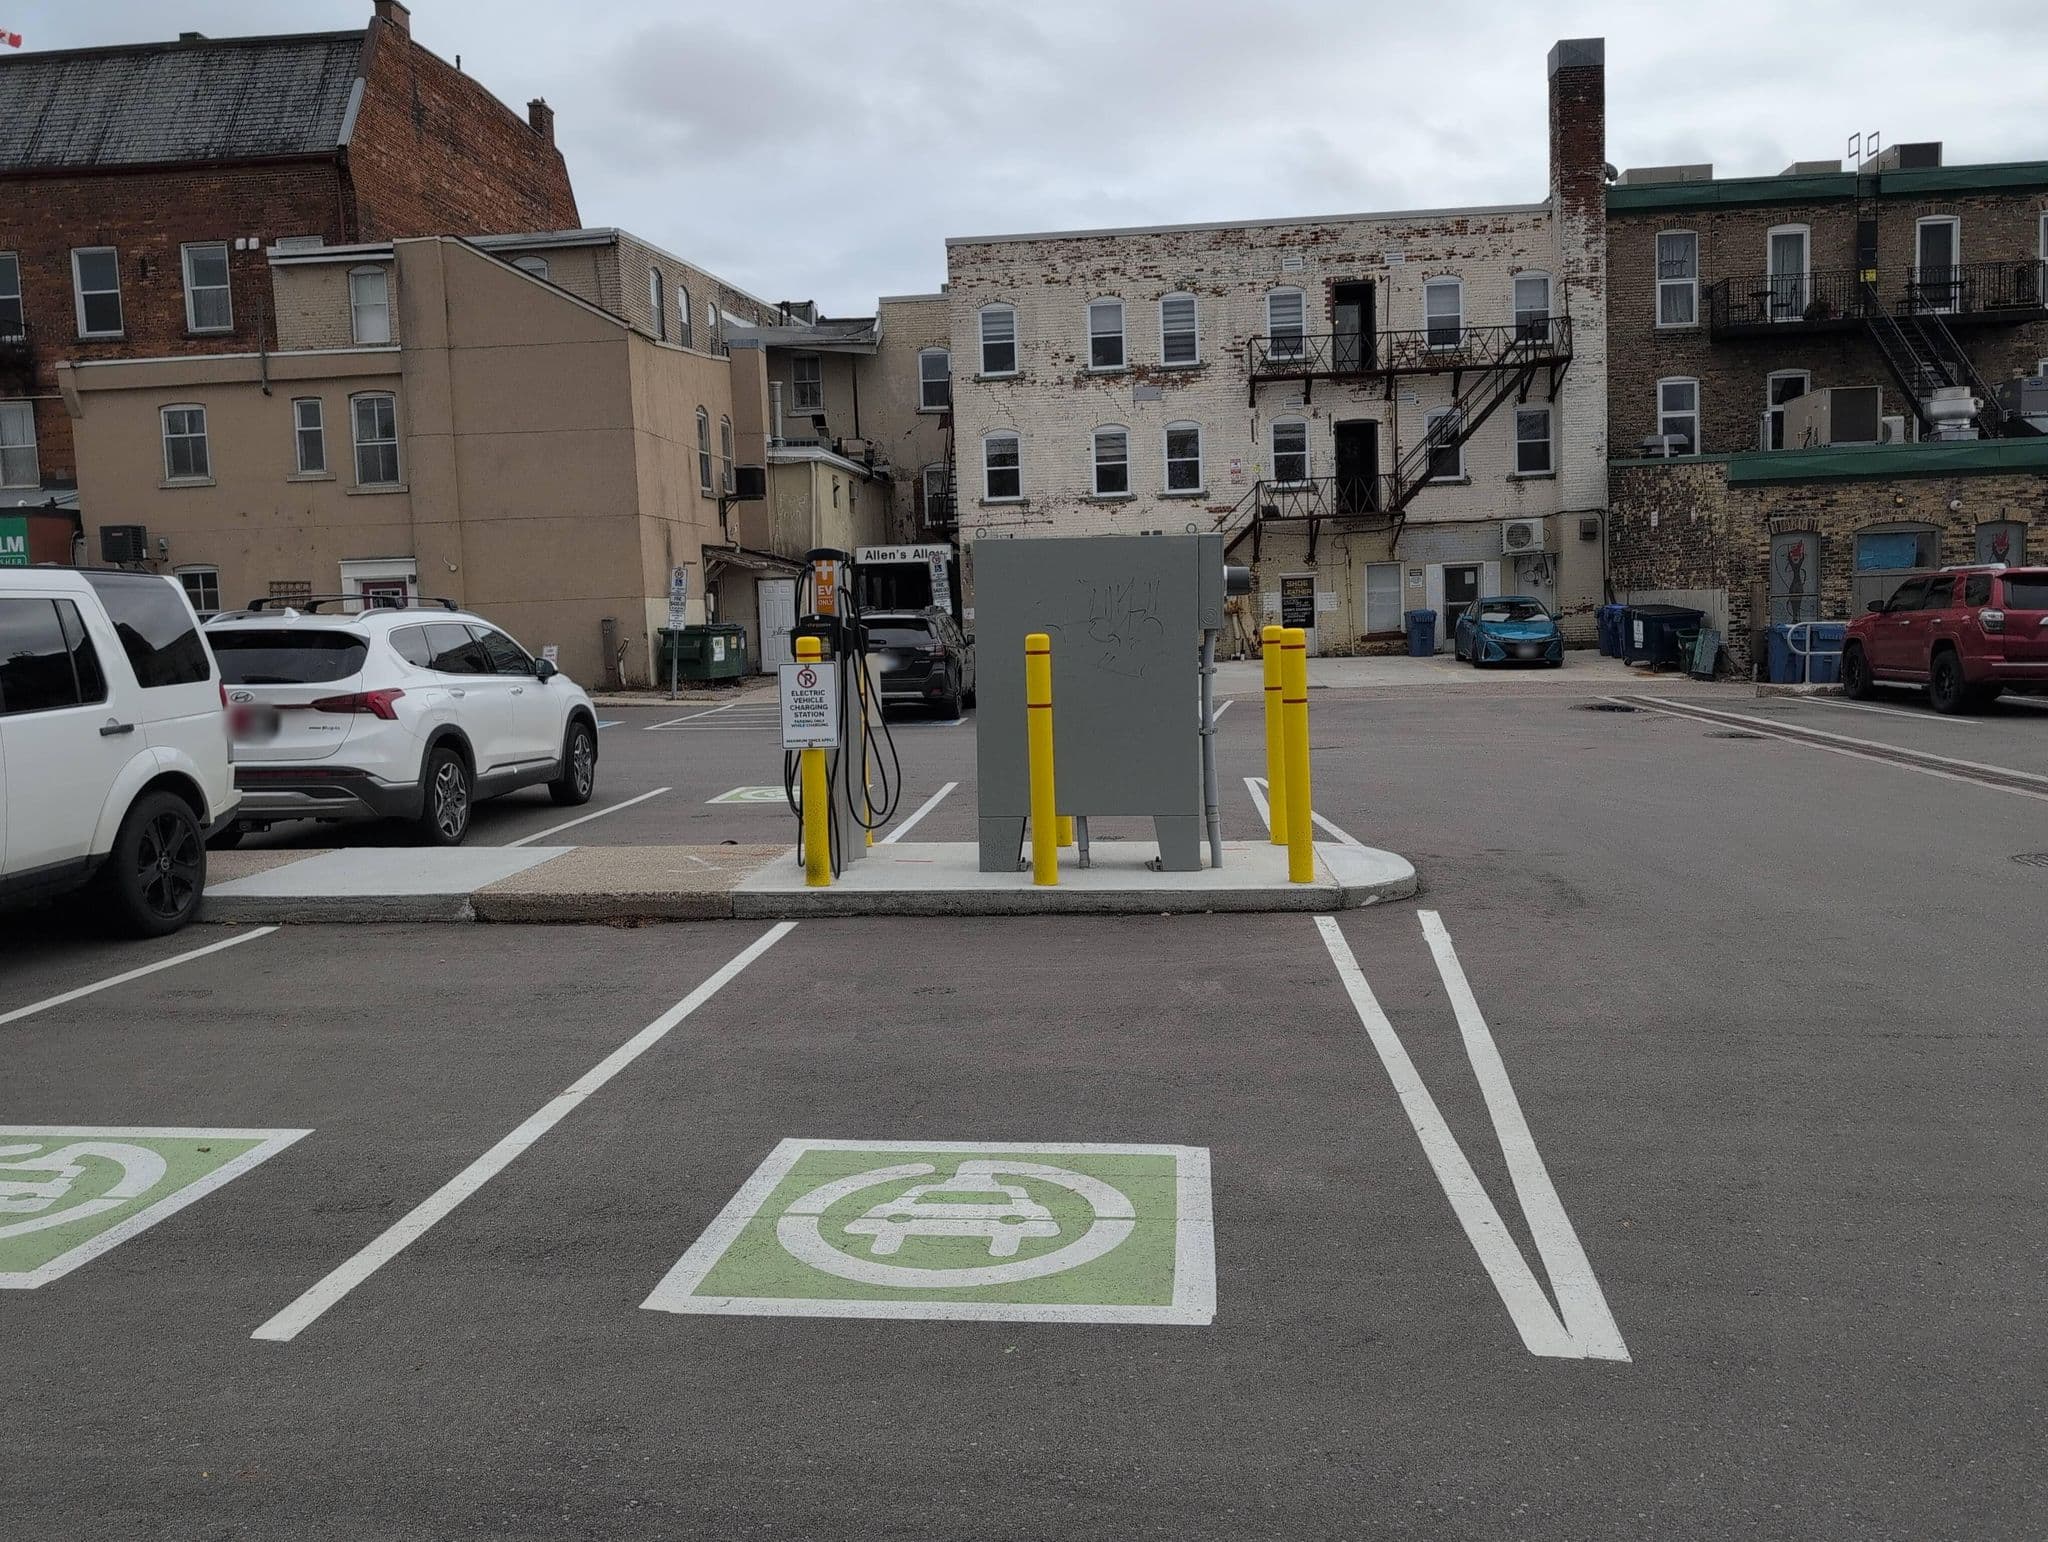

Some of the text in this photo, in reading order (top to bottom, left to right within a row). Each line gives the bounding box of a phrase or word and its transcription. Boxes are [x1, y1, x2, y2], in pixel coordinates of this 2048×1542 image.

[864, 548, 944, 561] Allen's Alle
[817, 585, 833, 595] EV
